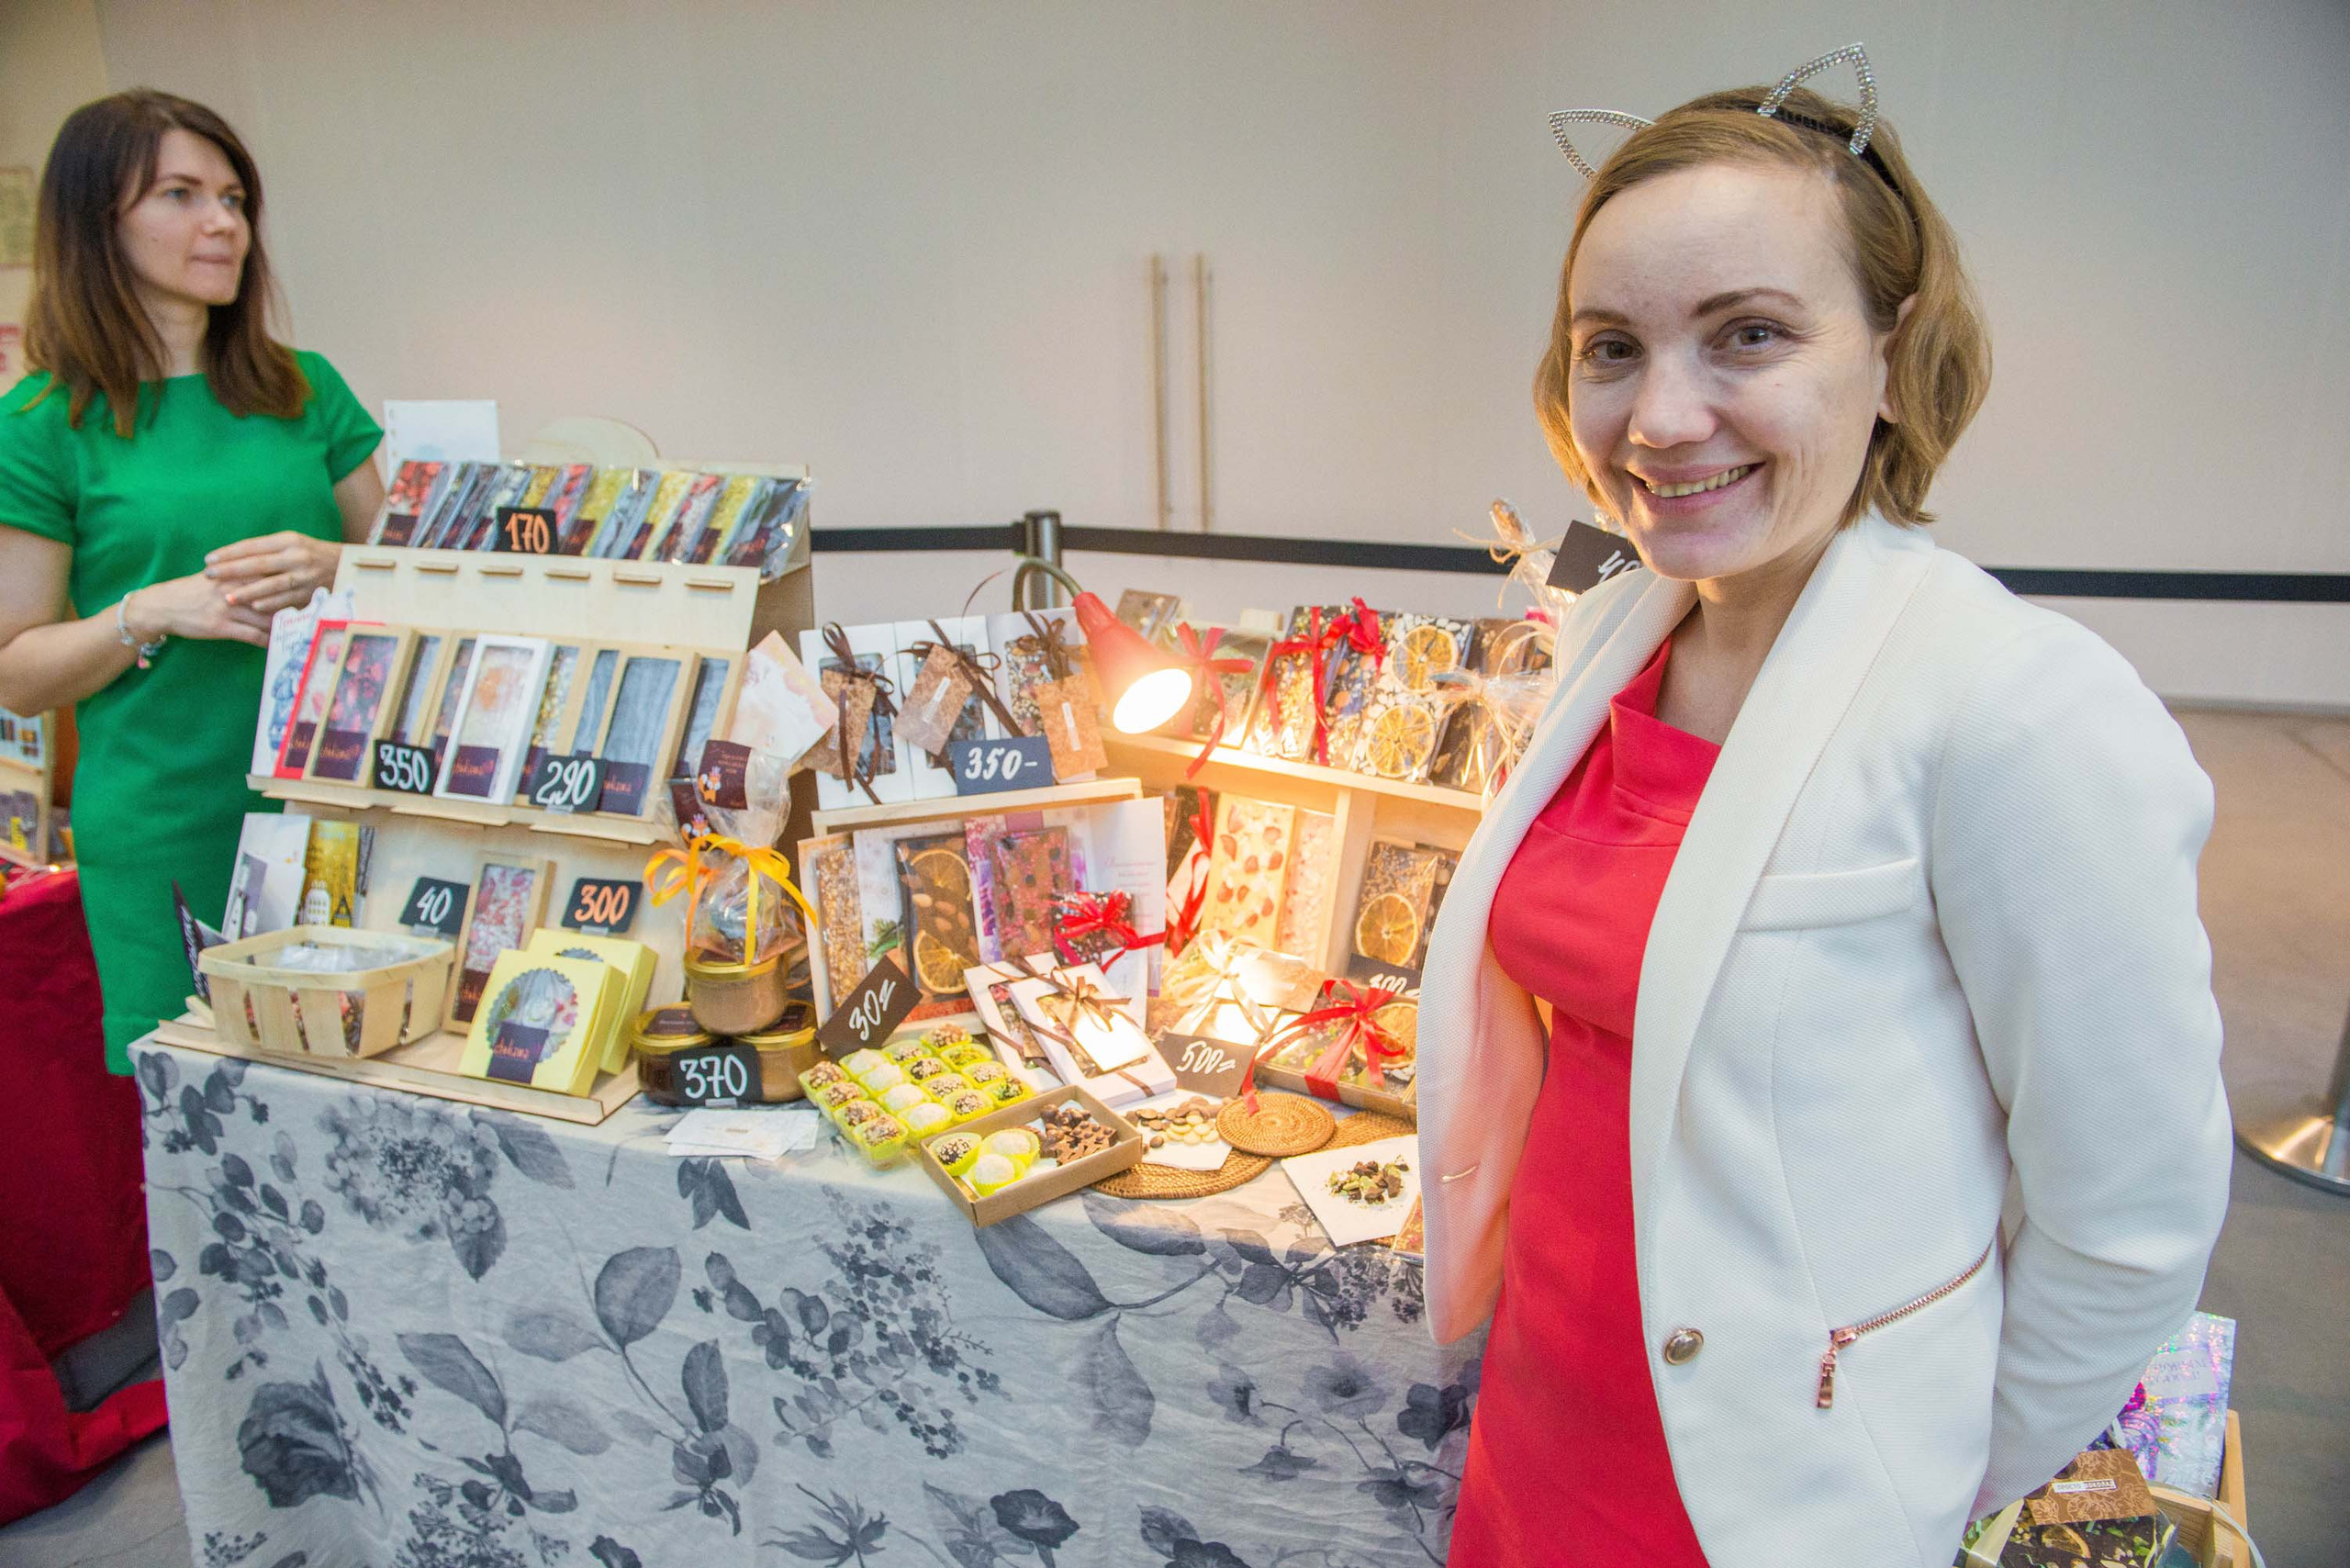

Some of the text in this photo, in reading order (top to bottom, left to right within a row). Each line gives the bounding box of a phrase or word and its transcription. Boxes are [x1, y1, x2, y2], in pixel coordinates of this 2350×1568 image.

[505, 512, 550, 554] 170
[380, 744, 431, 793] 350
[536, 759, 597, 806] 290
[417, 886, 453, 924] 40
[575, 884, 630, 925] 300
[679, 1054, 748, 1099] 370
